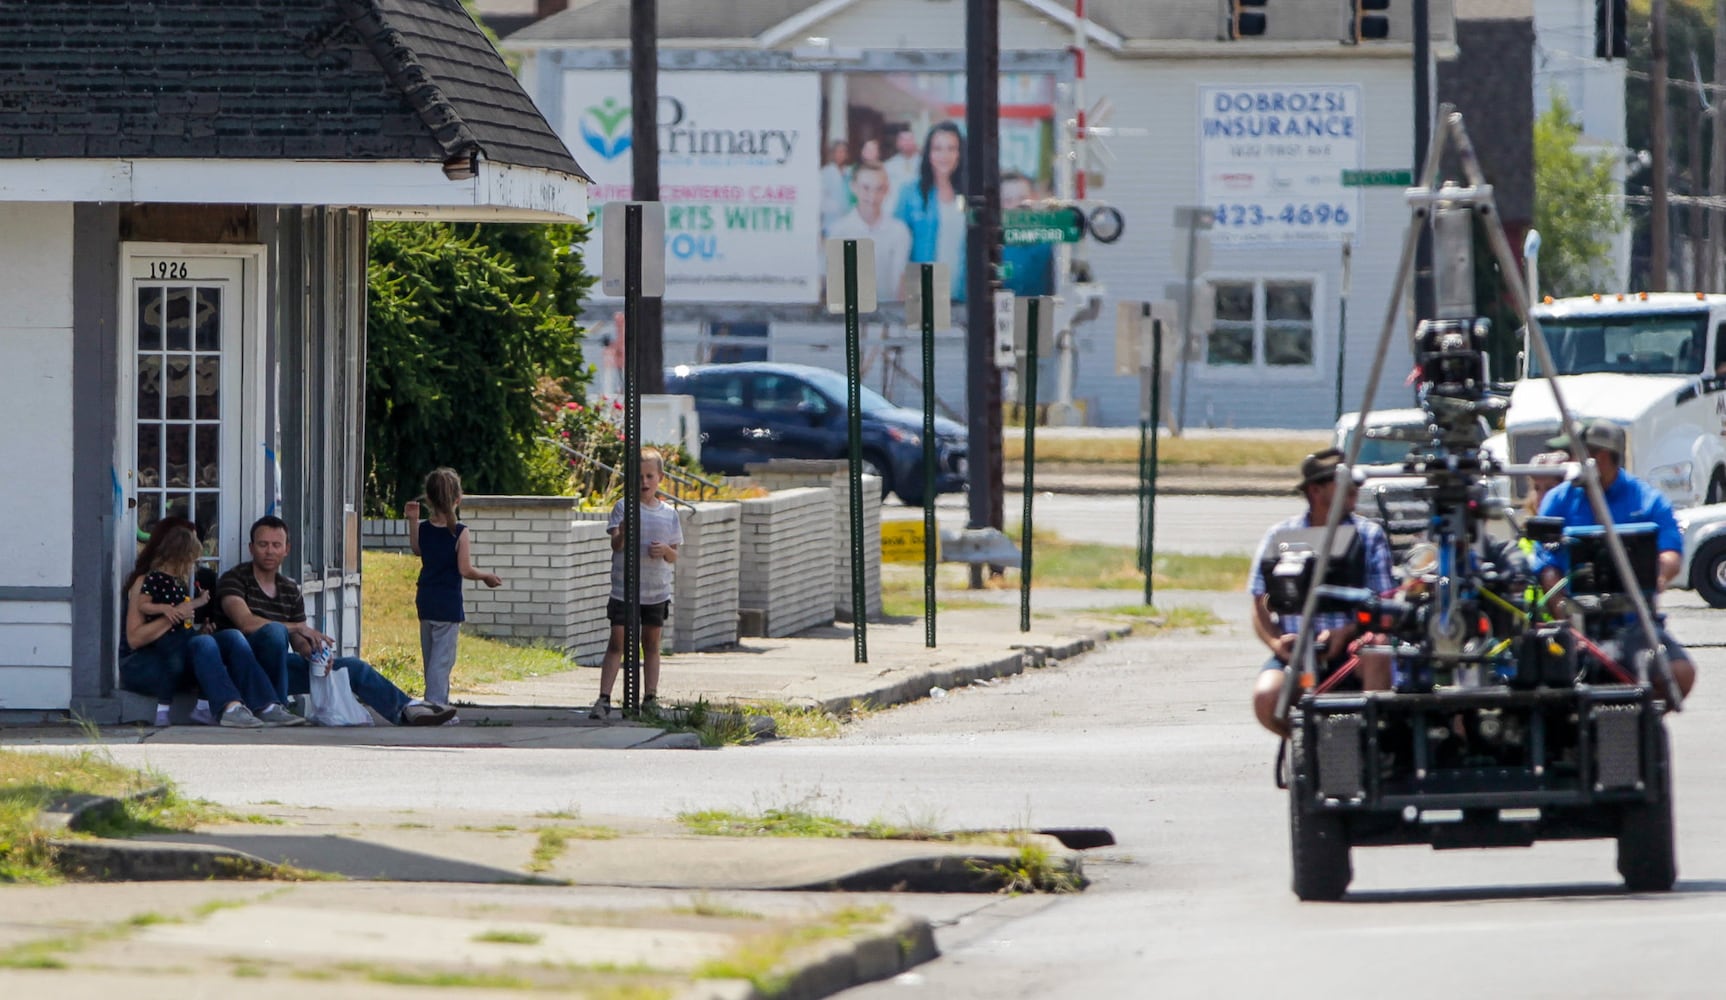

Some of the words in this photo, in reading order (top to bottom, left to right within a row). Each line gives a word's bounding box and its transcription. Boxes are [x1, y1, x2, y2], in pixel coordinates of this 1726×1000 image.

[751, 184, 797, 200] CARE
[725, 205, 794, 231] WITH
[1213, 202, 1349, 226] 423-4696
[150, 261, 188, 279] 1926
